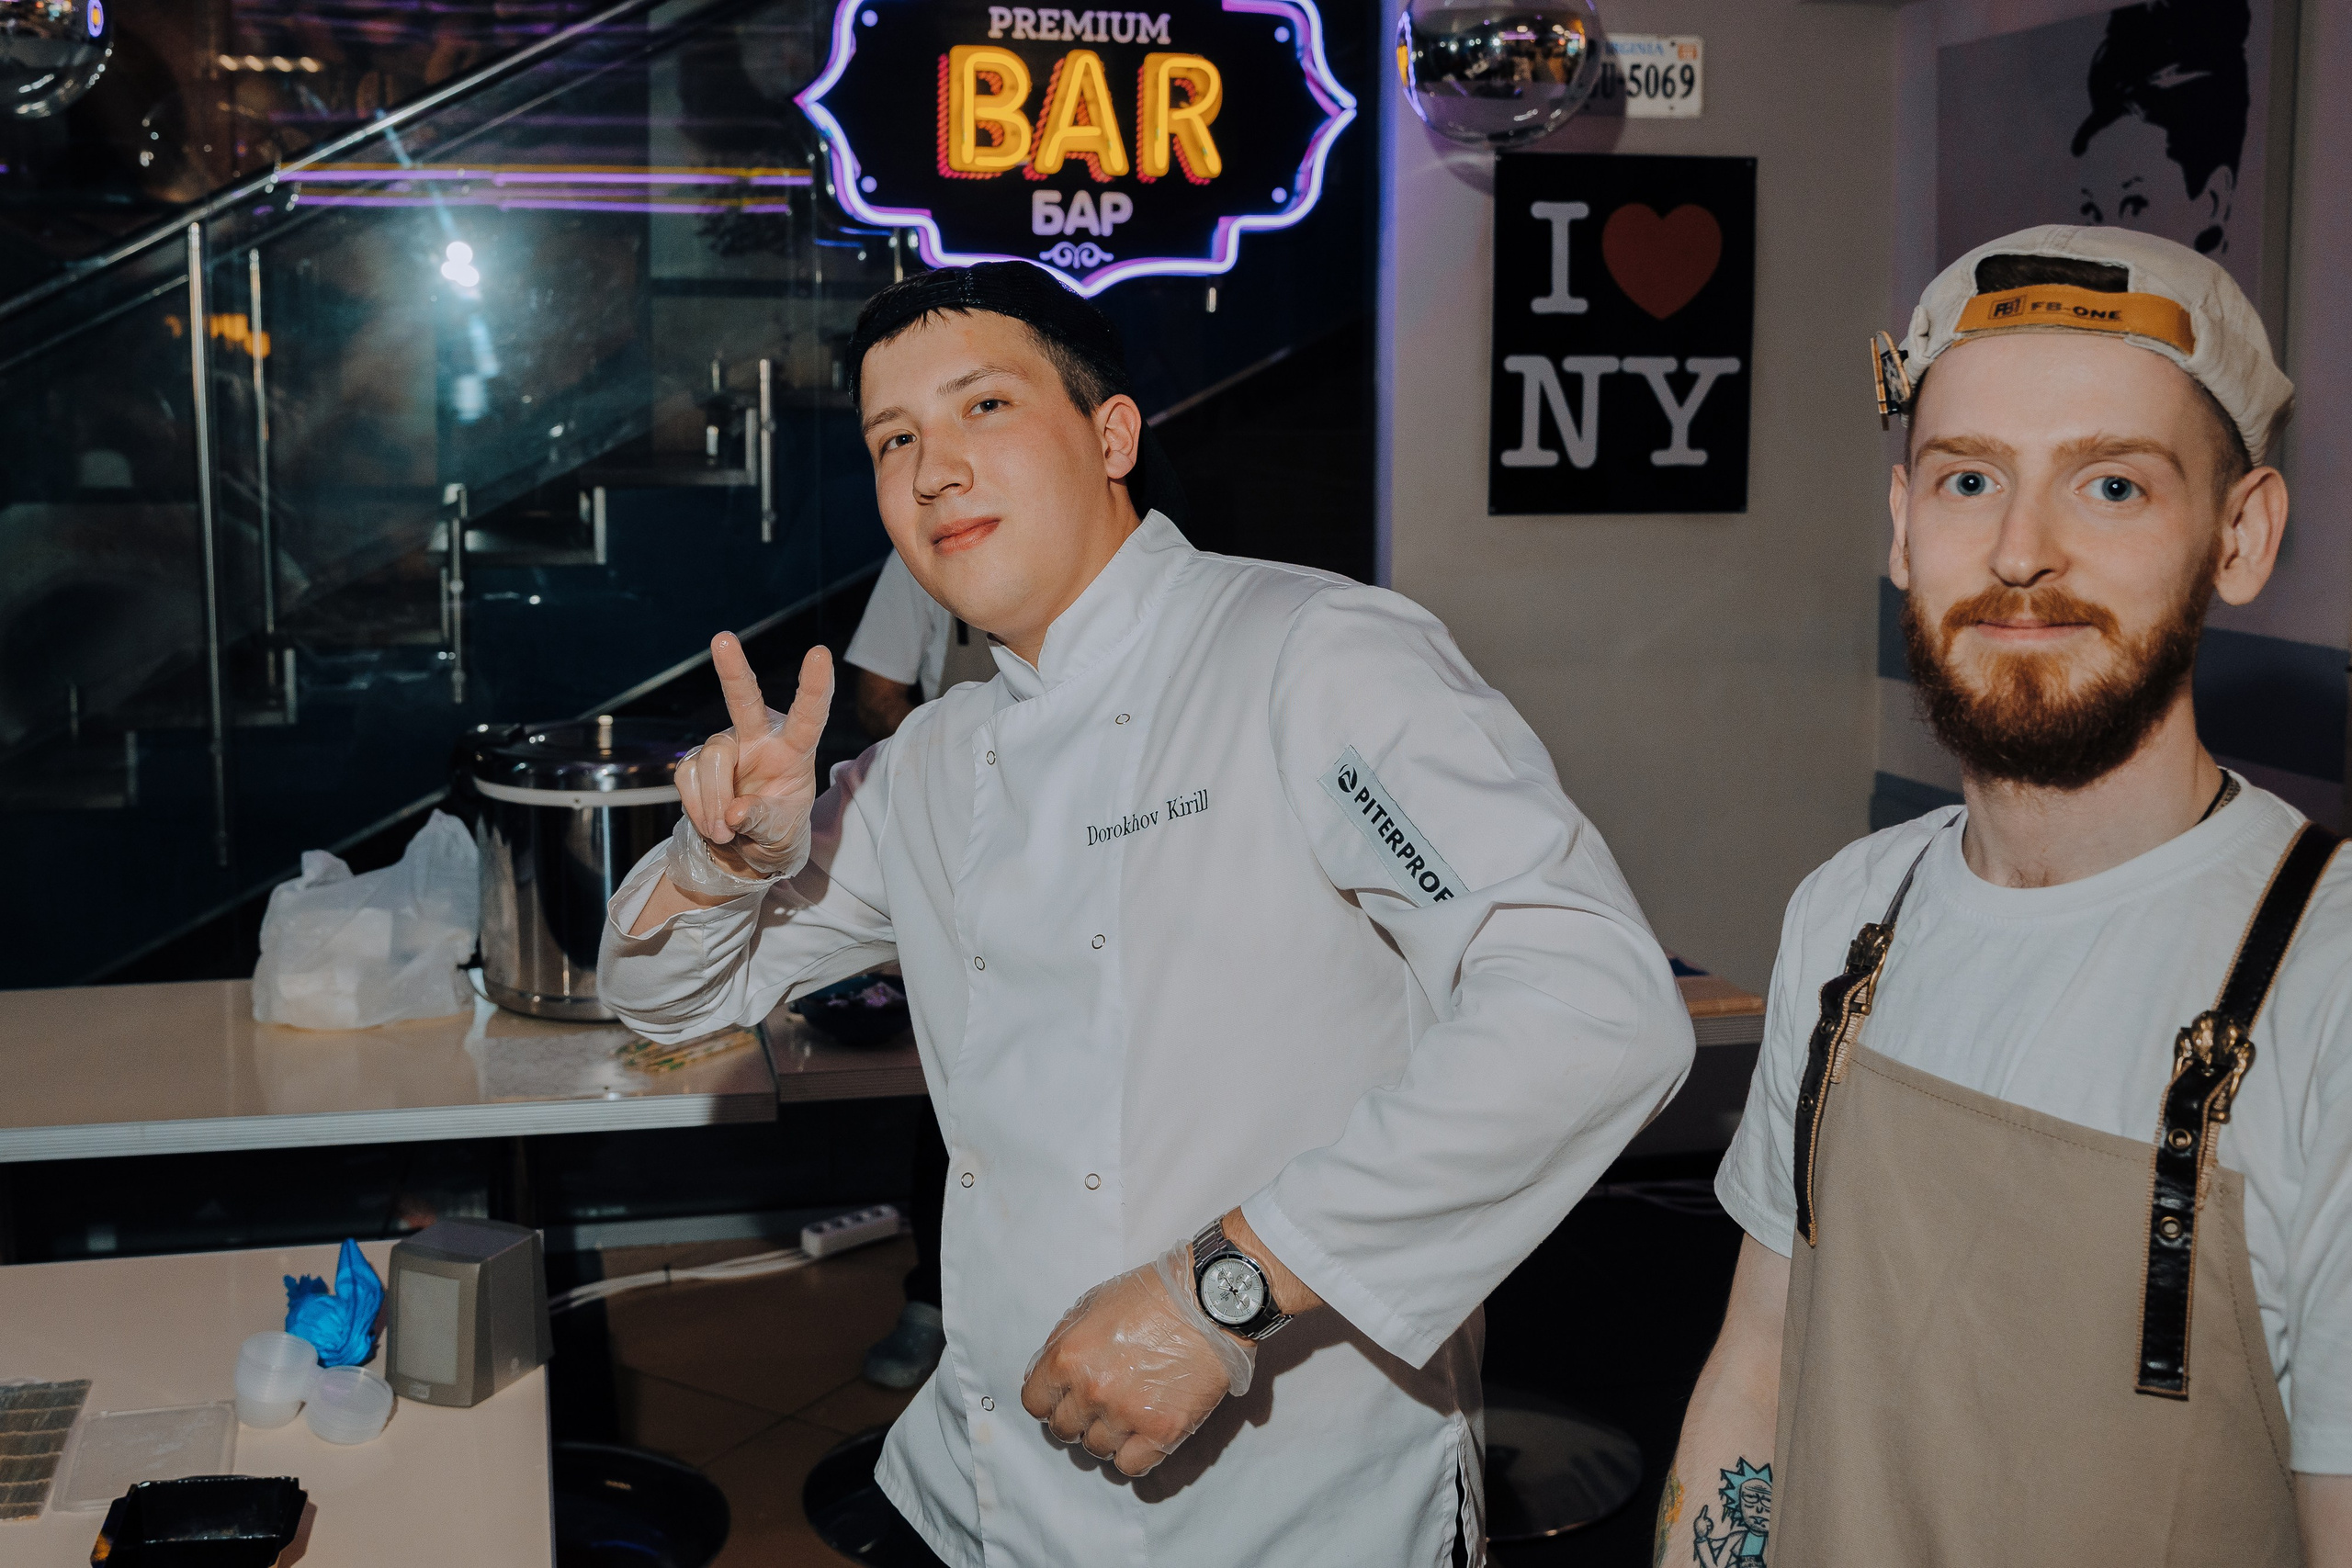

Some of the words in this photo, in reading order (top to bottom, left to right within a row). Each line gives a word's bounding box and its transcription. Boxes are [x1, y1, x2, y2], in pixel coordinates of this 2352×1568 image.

[988, 6, 1172, 45] PREMIUM
[937, 45, 1223, 185] BAR
[1031, 189, 1134, 237] БАР
[1531, 201, 1589, 314] I
[2030, 300, 2123, 321] FB-ONE
[1500, 355, 1741, 469] NY
[1086, 810, 1159, 847] Dorokhov
[1165, 788, 1209, 821] Kirill
[1353, 785, 1455, 903] PITERPROF
